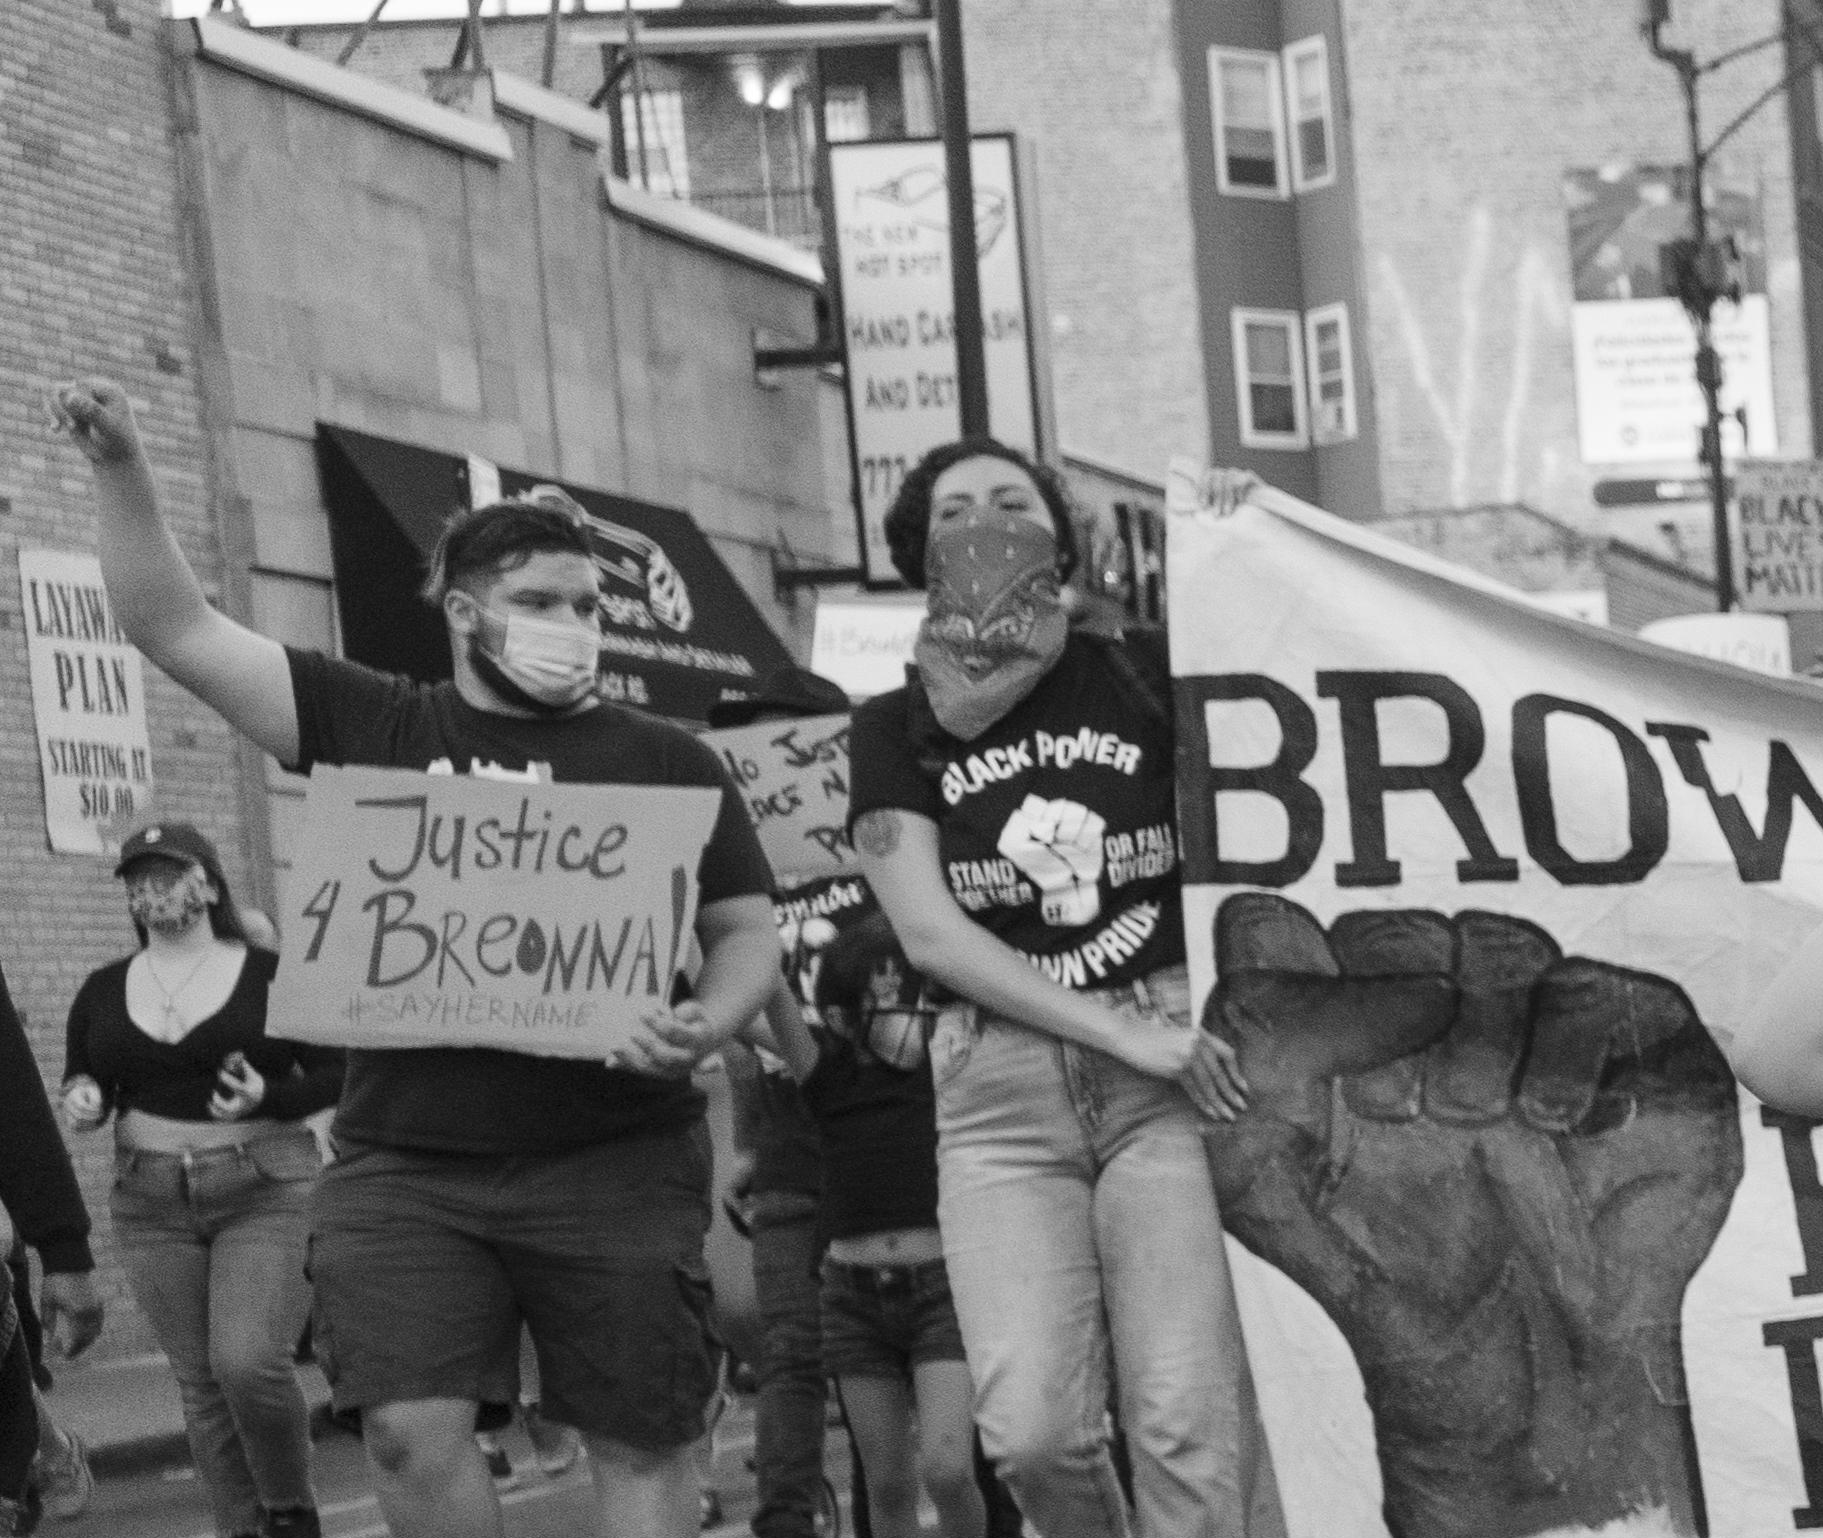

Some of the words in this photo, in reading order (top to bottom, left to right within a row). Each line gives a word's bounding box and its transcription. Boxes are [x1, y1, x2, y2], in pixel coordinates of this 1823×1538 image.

[848, 313, 911, 351] HAND
[866, 374, 911, 411] AND
[54, 651, 130, 717] PLAN
[48, 739, 127, 781] STARTING
[942, 738, 1033, 805] BLACK
[1035, 726, 1141, 775] POWER
[354, 795, 629, 882] Justice
[1105, 834, 1134, 861] OR
[949, 859, 1016, 891] STAND
[302, 880, 341, 963] 4
[341, 992, 597, 1029] #SAYHERNAME
